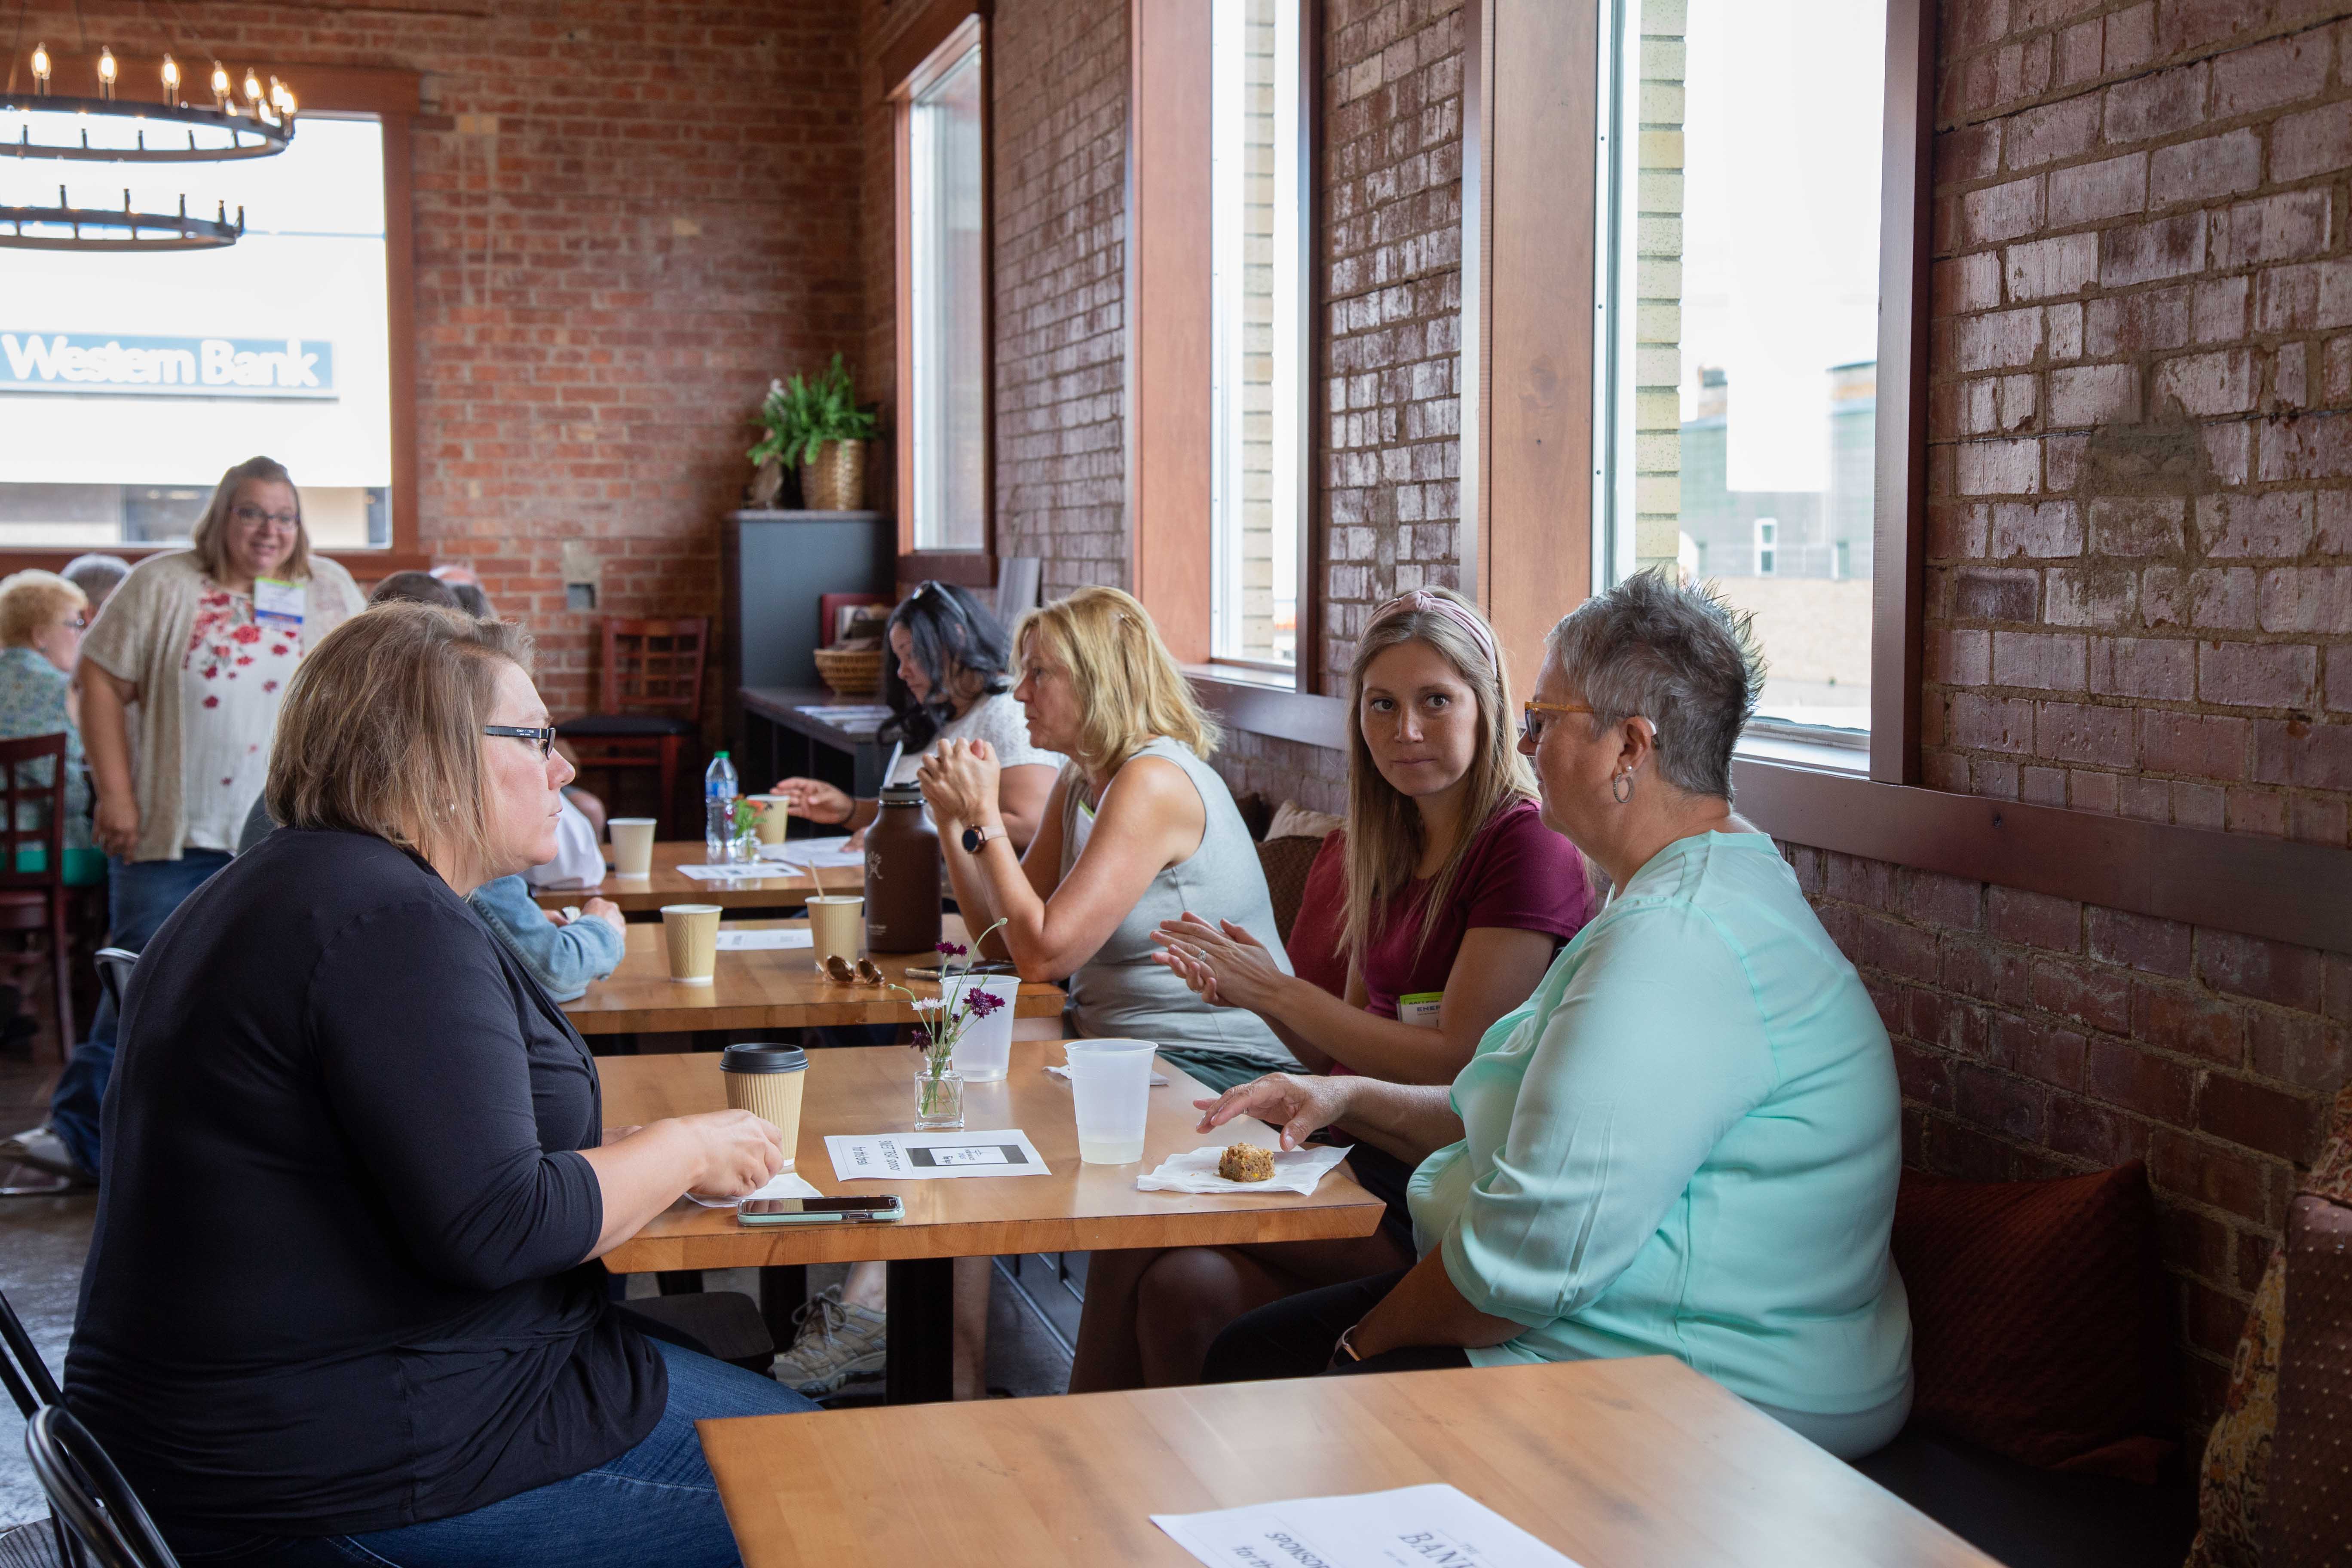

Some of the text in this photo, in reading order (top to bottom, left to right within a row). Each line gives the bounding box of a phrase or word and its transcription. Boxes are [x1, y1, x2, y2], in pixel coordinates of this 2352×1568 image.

[1, 334, 320, 387] Western Bank
[855, 1157, 873, 1165] break
[878, 1140, 901, 1171] SWEET TREAT sponsor
[1231, 1547, 1259, 1560] for
